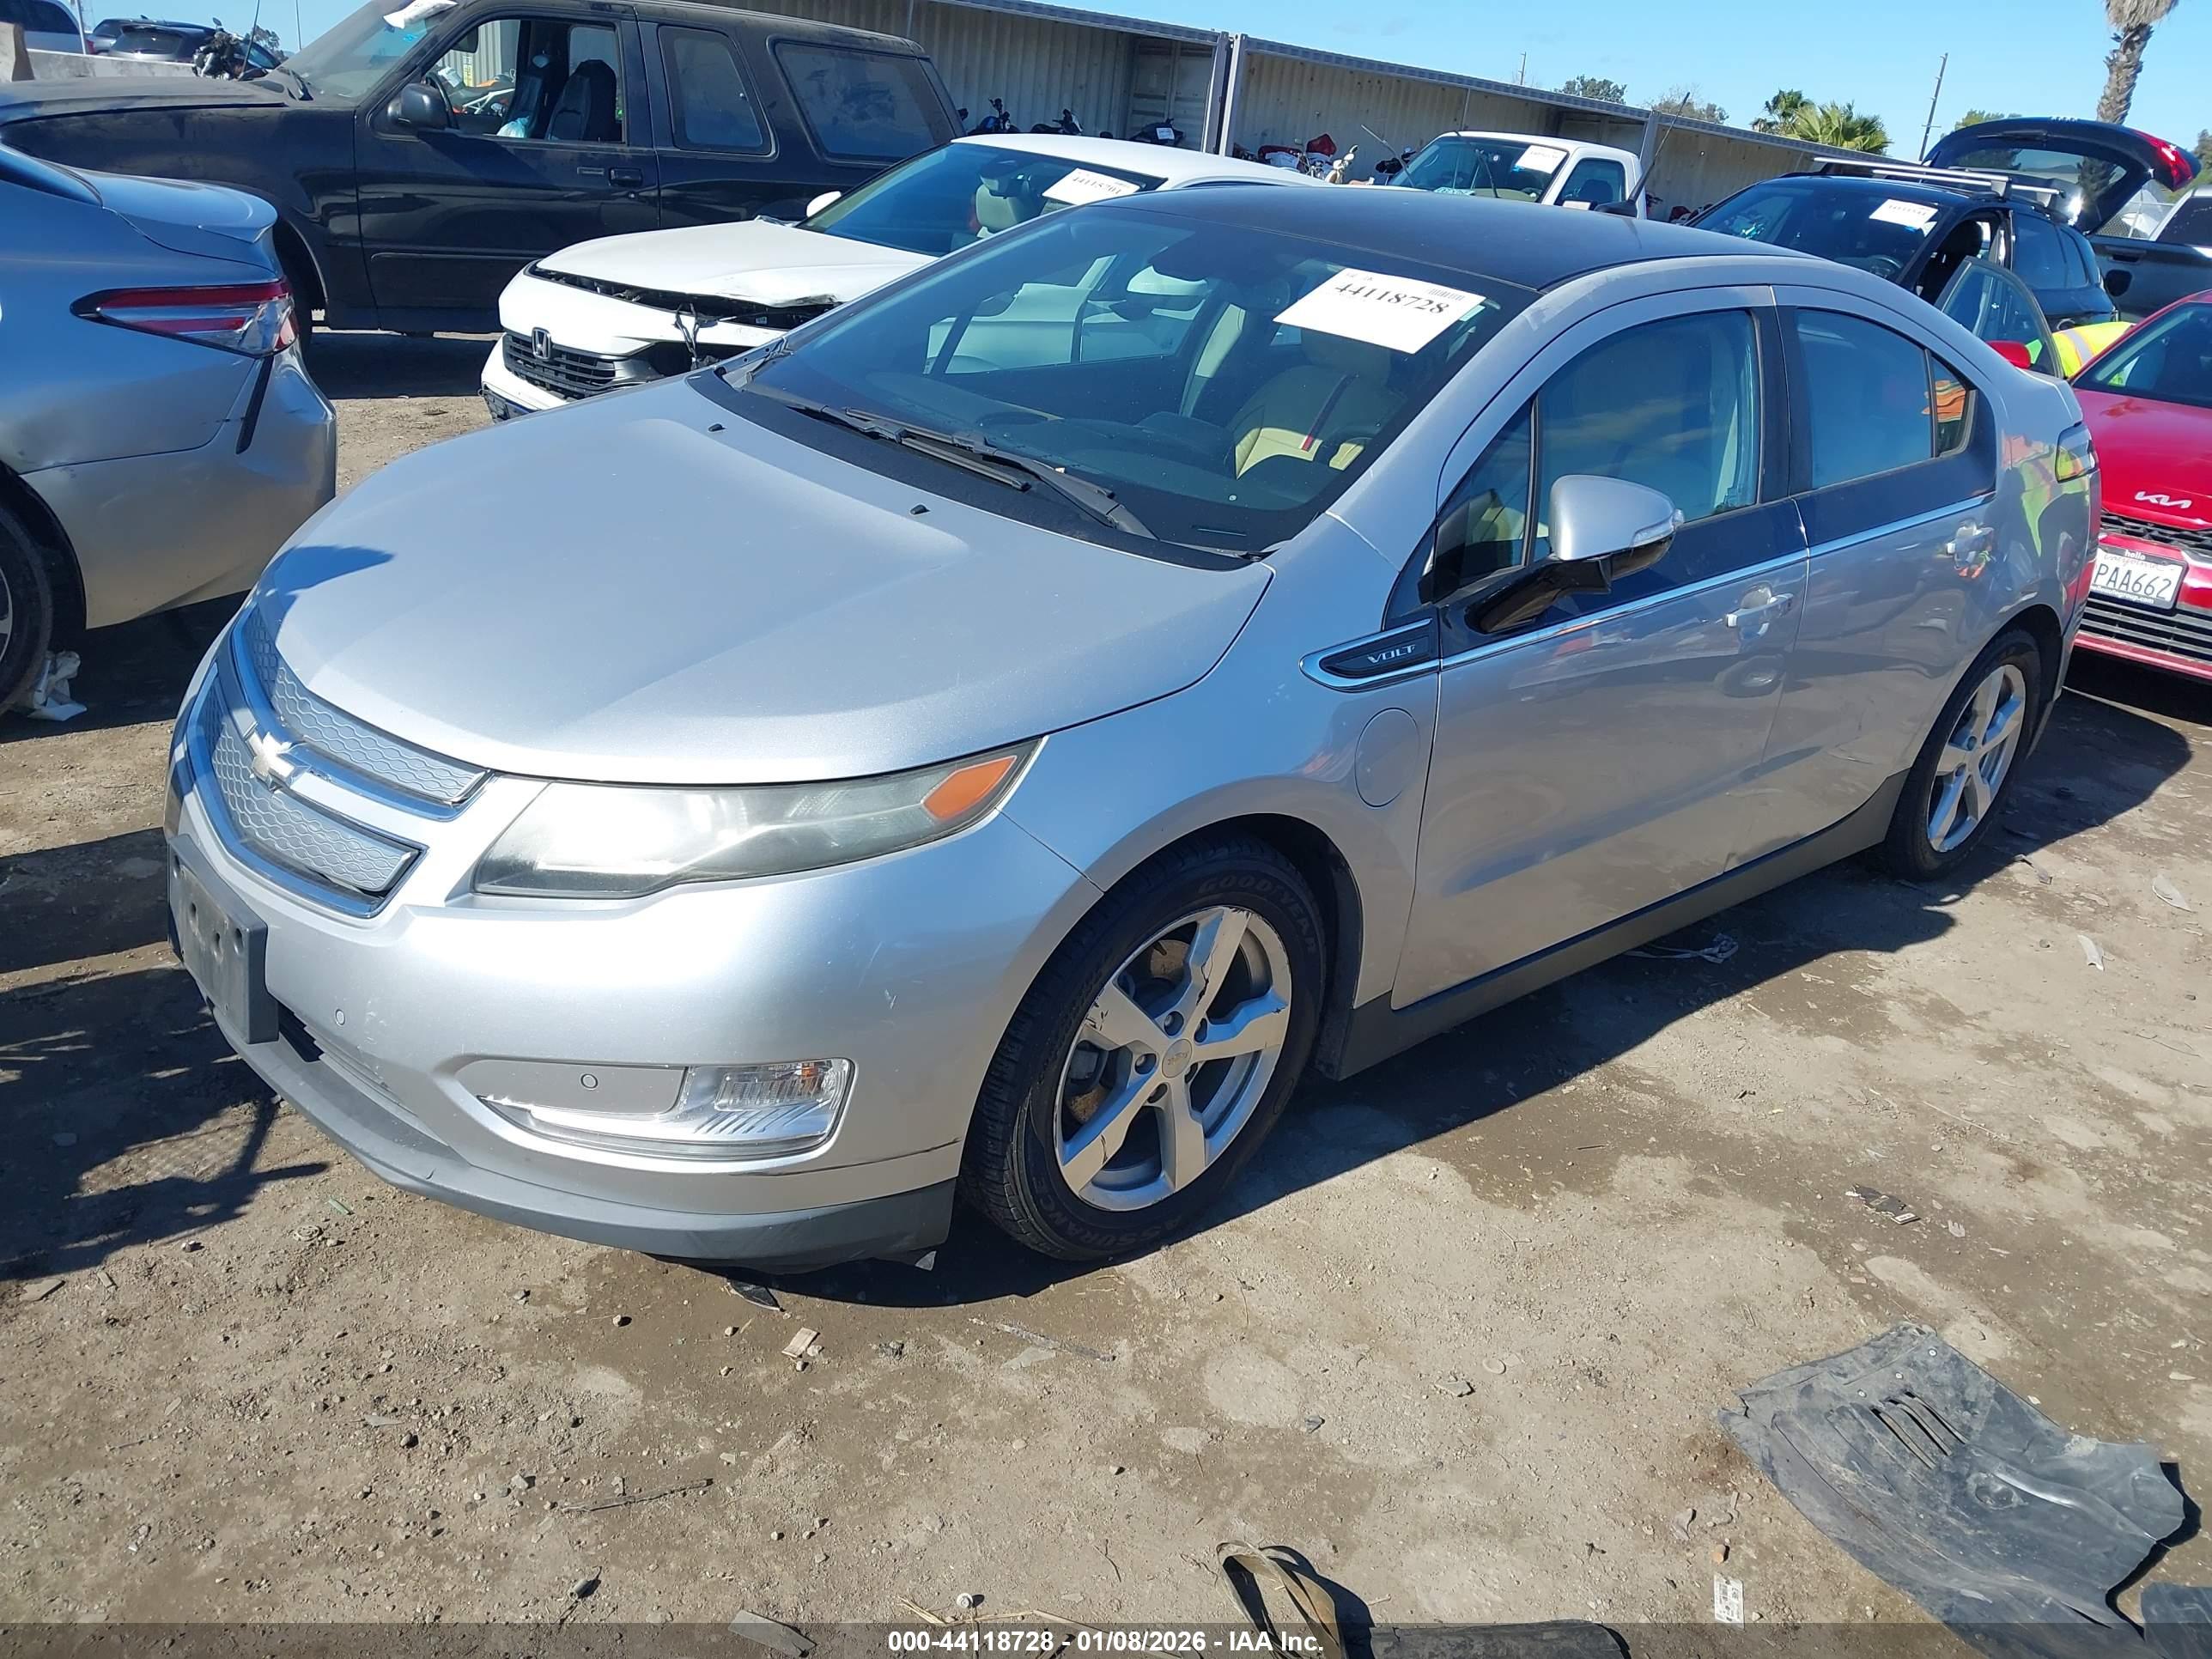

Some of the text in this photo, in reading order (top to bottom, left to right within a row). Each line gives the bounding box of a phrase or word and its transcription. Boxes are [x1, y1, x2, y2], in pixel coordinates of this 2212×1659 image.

[1335, 283, 1449, 314] 44118728
[2124, 550, 2146, 561] hello
[2094, 562, 2172, 599] PAA662
[1367, 645, 1415, 663] VOLT
[1198, 874, 1317, 954] GOODYEAR
[1032, 1176, 1182, 1247] ASSURANCE
